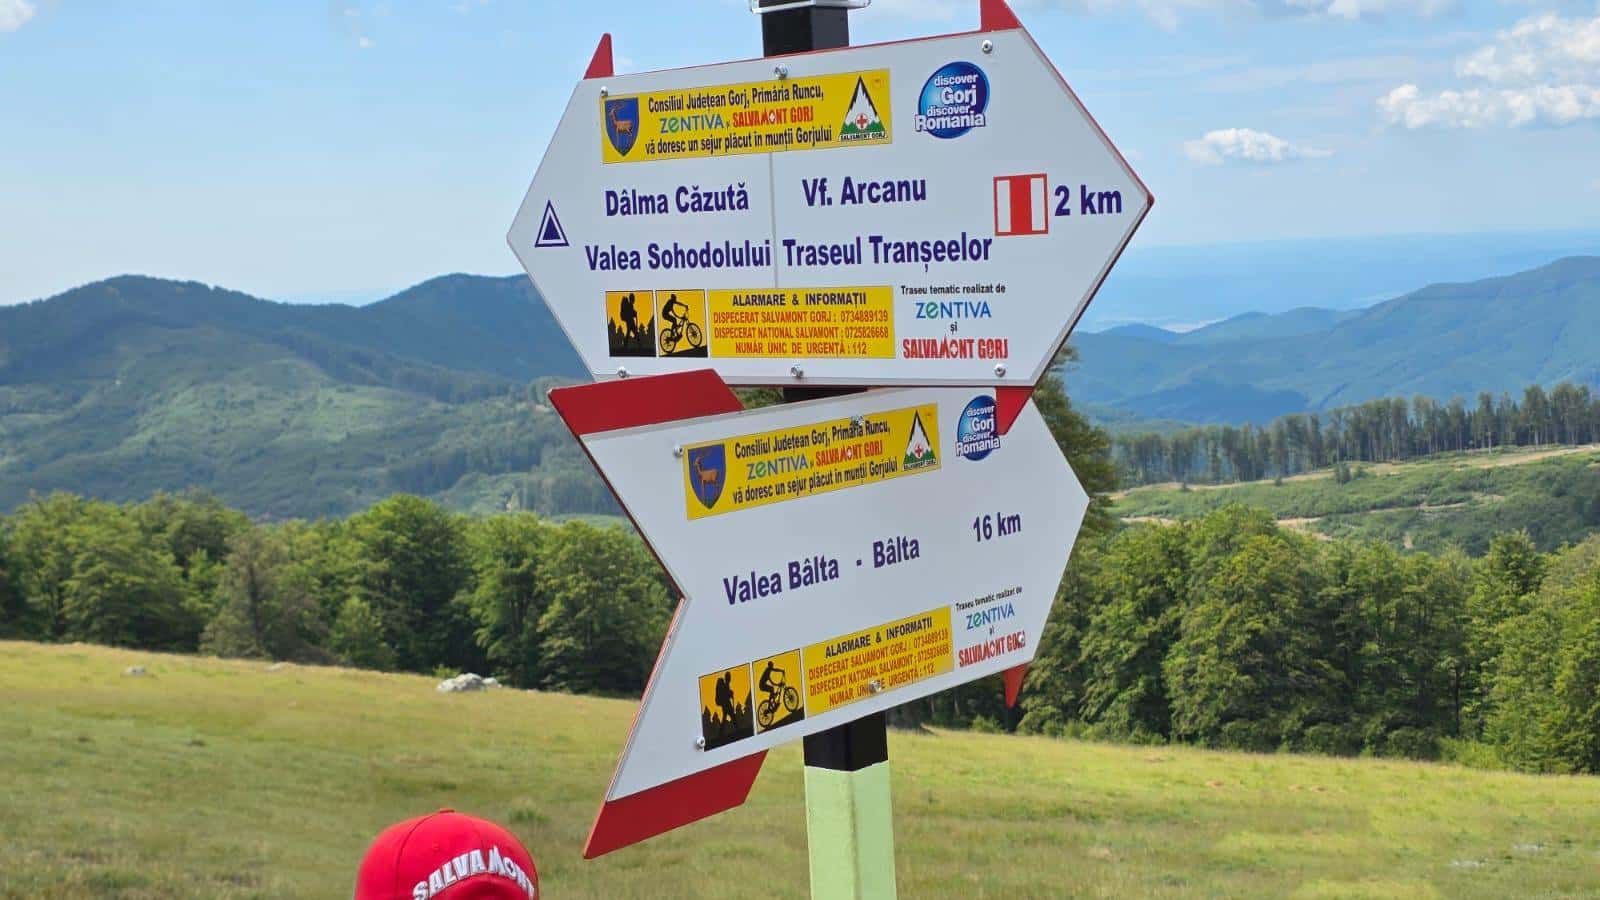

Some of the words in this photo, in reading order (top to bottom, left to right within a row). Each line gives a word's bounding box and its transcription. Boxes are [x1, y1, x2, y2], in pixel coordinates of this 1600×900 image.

[934, 74, 979, 86] discover
[648, 95, 684, 113] Consiliul
[728, 89, 750, 108] Gorj,
[792, 83, 824, 101] Runcu,
[941, 84, 977, 106] Gorj
[732, 107, 788, 128] SALVAMONT
[790, 105, 814, 123] GORJ
[914, 110, 986, 132] Romania
[926, 105, 970, 117] discover
[645, 139, 655, 154] vă
[658, 137, 686, 153] doresc
[688, 139, 698, 151] un
[701, 134, 722, 154] sejur
[796, 125, 832, 146] Gorjului
[605, 189, 669, 217] Dâlma
[675, 182, 749, 213] Căzută
[802, 177, 833, 206] Vf.
[840, 176, 927, 205] Arcanu
[1054, 185, 1071, 217] 2
[1080, 184, 1122, 215] km
[585, 244, 641, 271] Valea
[648, 239, 771, 270] Sohodolului
[782, 236, 862, 266] Traseul
[868, 231, 993, 273] Tranșeelor
[732, 294, 786, 307] ALARMARE
[792, 293, 799, 306] &
[901, 285, 928, 295] Traseu
[930, 283, 960, 295] tematic
[962, 282, 993, 294] realizat
[995, 282, 1006, 293] de
[713, 311, 759, 323] DISPECERAT
[761, 311, 807, 323] SALVAMONT
[810, 311, 832, 323] GORJ
[714, 327, 756, 339] DISPECERAT
[795, 327, 839, 339] SALVAMONT
[767, 342, 788, 354] UNIC
[791, 342, 802, 354] DE
[852, 341, 868, 355] 112
[902, 335, 975, 359] SALVAMONT
[977, 337, 1009, 359] GORJ
[971, 414, 995, 432] Gorj
[735, 437, 771, 459] Consiliul
[811, 429, 831, 448] Gorj,
[865, 418, 890, 436] Runcu,
[955, 434, 1001, 457] Romania
[816, 443, 862, 467] SALVAMONT
[864, 440, 883, 457] GORJ
[745, 483, 773, 501] doresc
[775, 482, 785, 496] un
[787, 476, 807, 496] sejur
[869, 456, 898, 478] Gorjului
[973, 514, 993, 542] 16
[998, 511, 1022, 537] km
[723, 571, 782, 605] Valea
[788, 555, 839, 590] Bâlta
[873, 536, 920, 568] Bâlta
[825, 634, 871, 659] ALARMARE
[959, 637, 1006, 667] SALVAMONT
[808, 658, 849, 681] DISPECERAT
[851, 645, 888, 668] SALVAMONT
[810, 674, 847, 697] DISPECERAT
[412, 845, 535, 900] SALVAMONT
